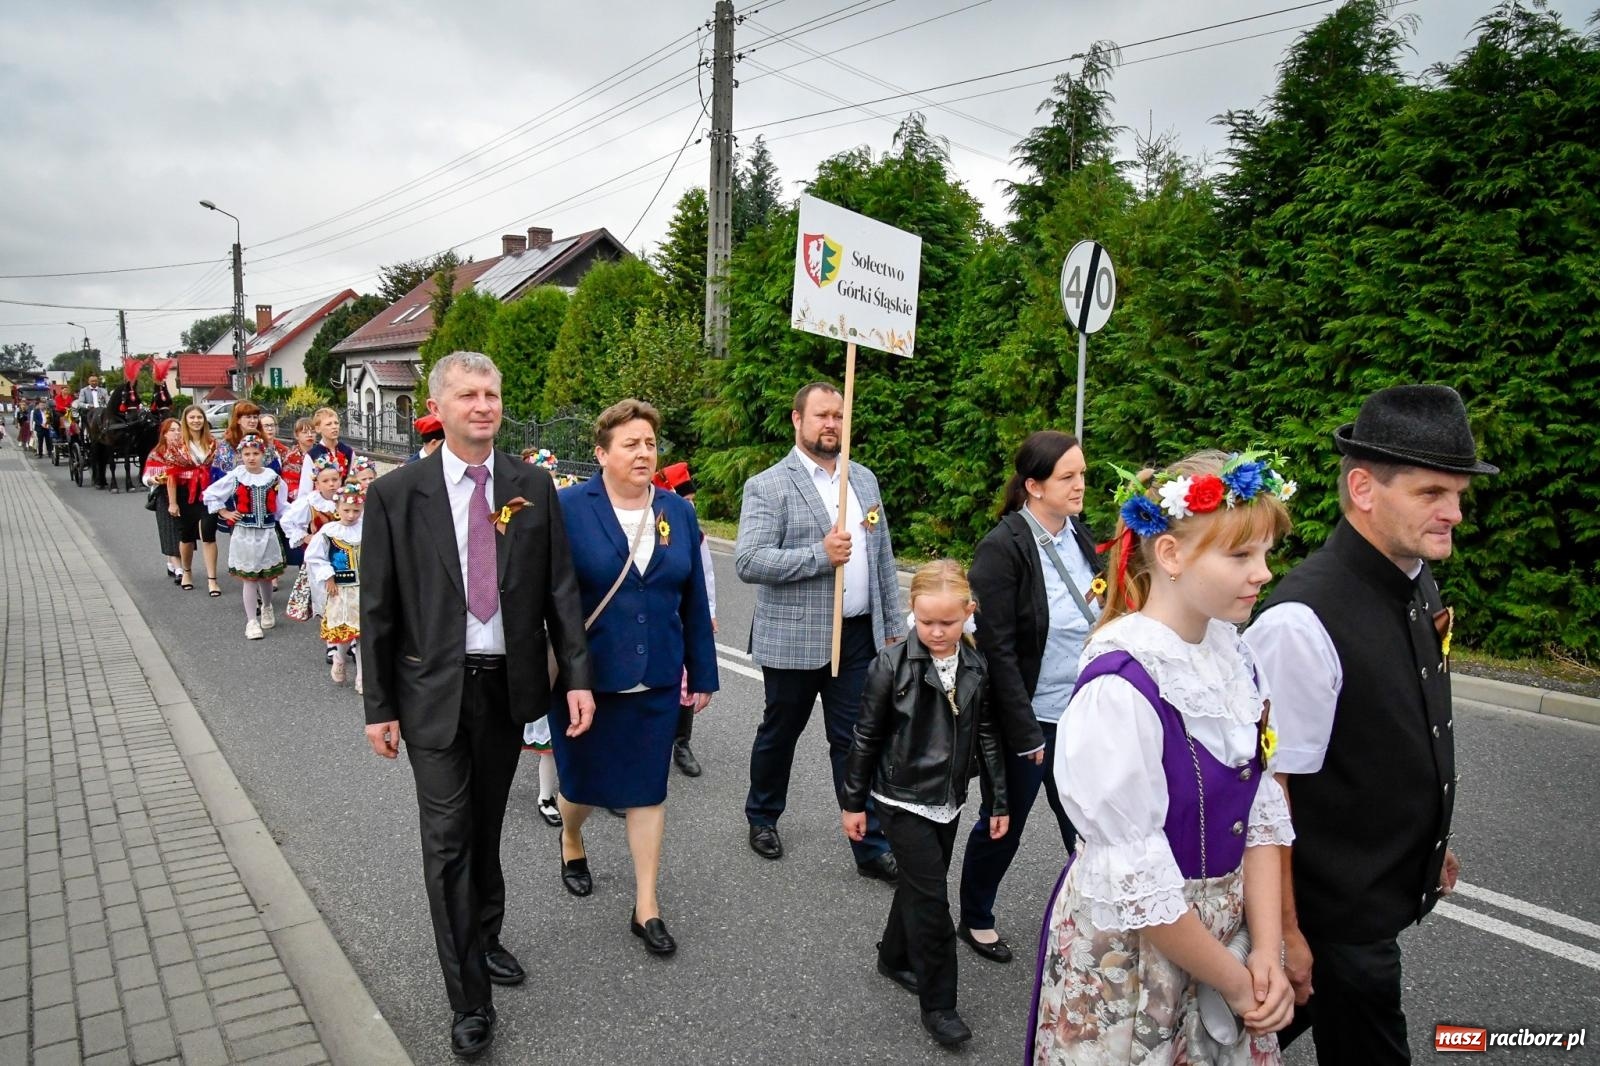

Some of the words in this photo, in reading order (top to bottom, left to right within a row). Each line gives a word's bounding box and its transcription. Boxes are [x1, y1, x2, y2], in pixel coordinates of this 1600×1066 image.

[837, 279, 872, 303] Górki
[873, 286, 913, 316] Śląskie
[1065, 265, 1113, 311] 40
